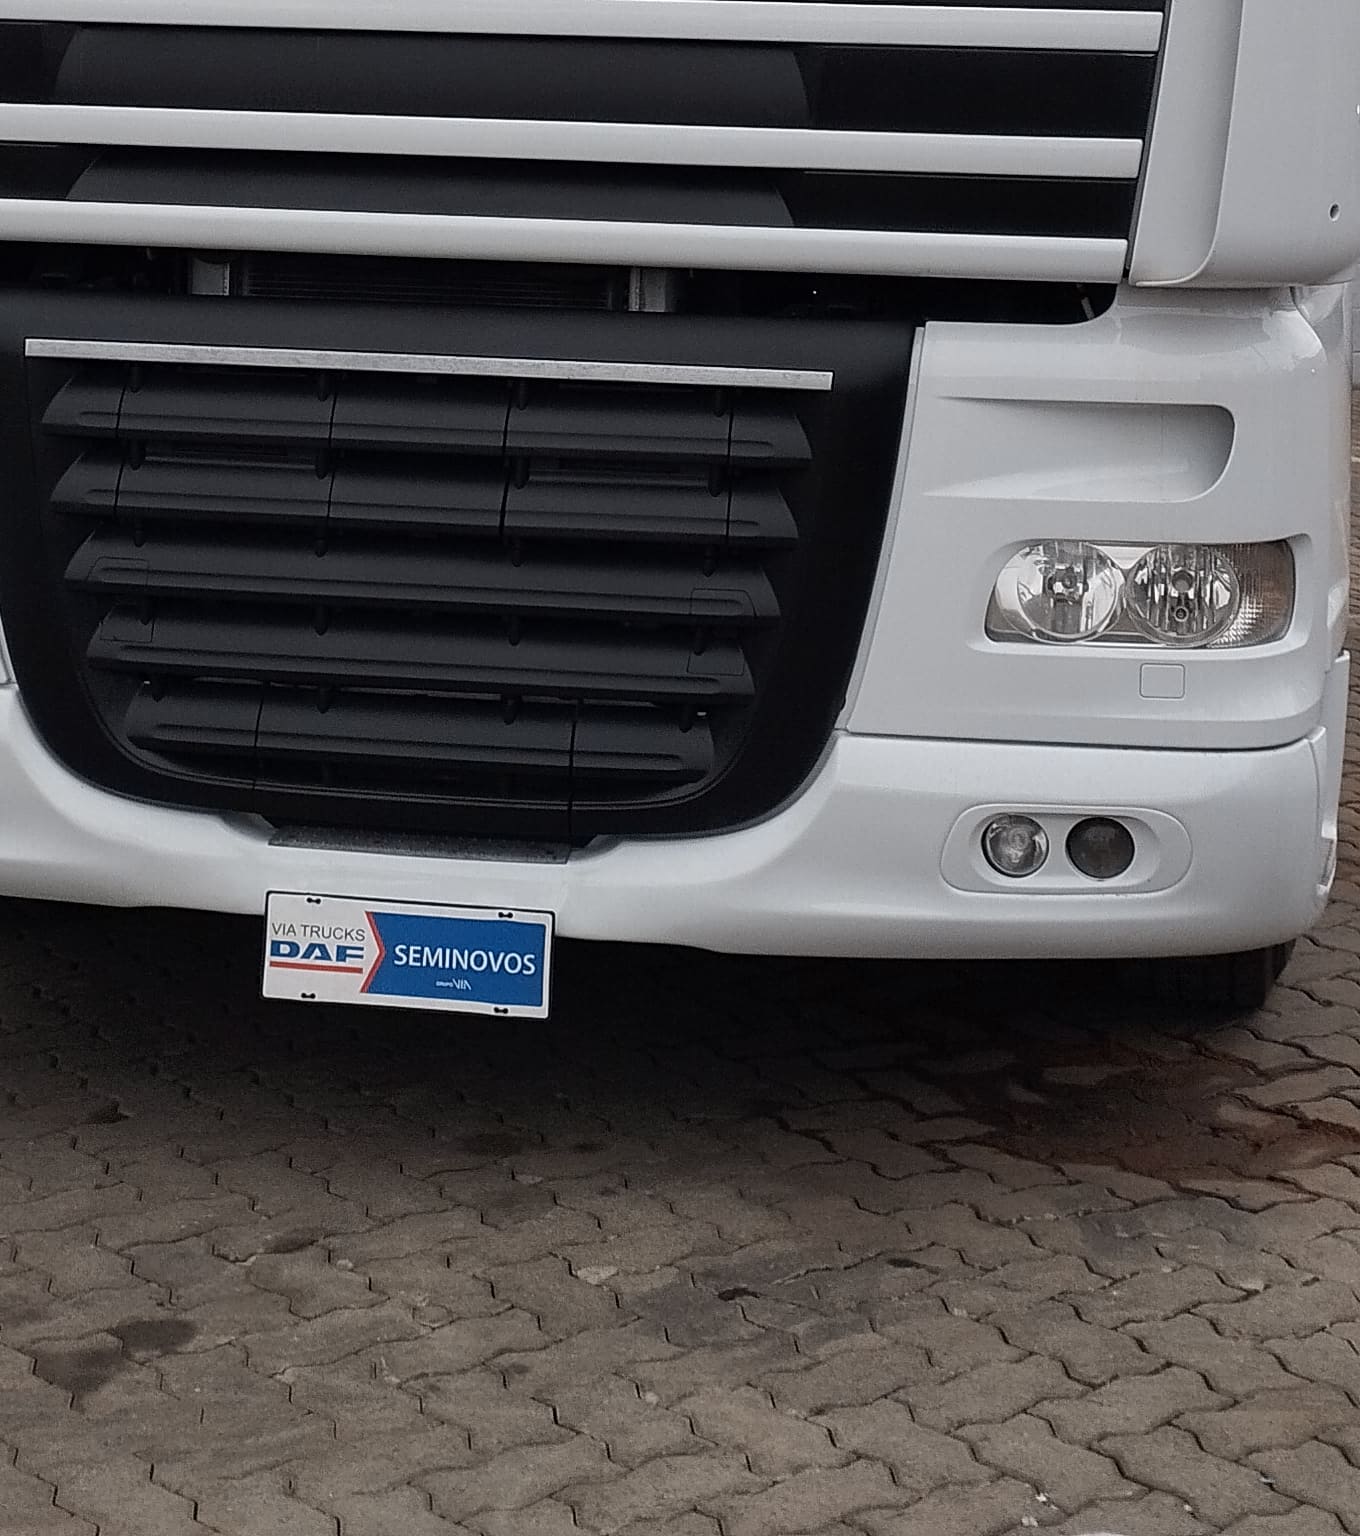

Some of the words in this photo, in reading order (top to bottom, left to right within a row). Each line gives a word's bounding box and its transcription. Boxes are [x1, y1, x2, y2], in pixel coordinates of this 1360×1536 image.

[271, 922, 297, 938] VIA
[300, 923, 366, 942] TRUCKS
[269, 939, 365, 963] DAF
[393, 943, 536, 976] SEMINOVOS
